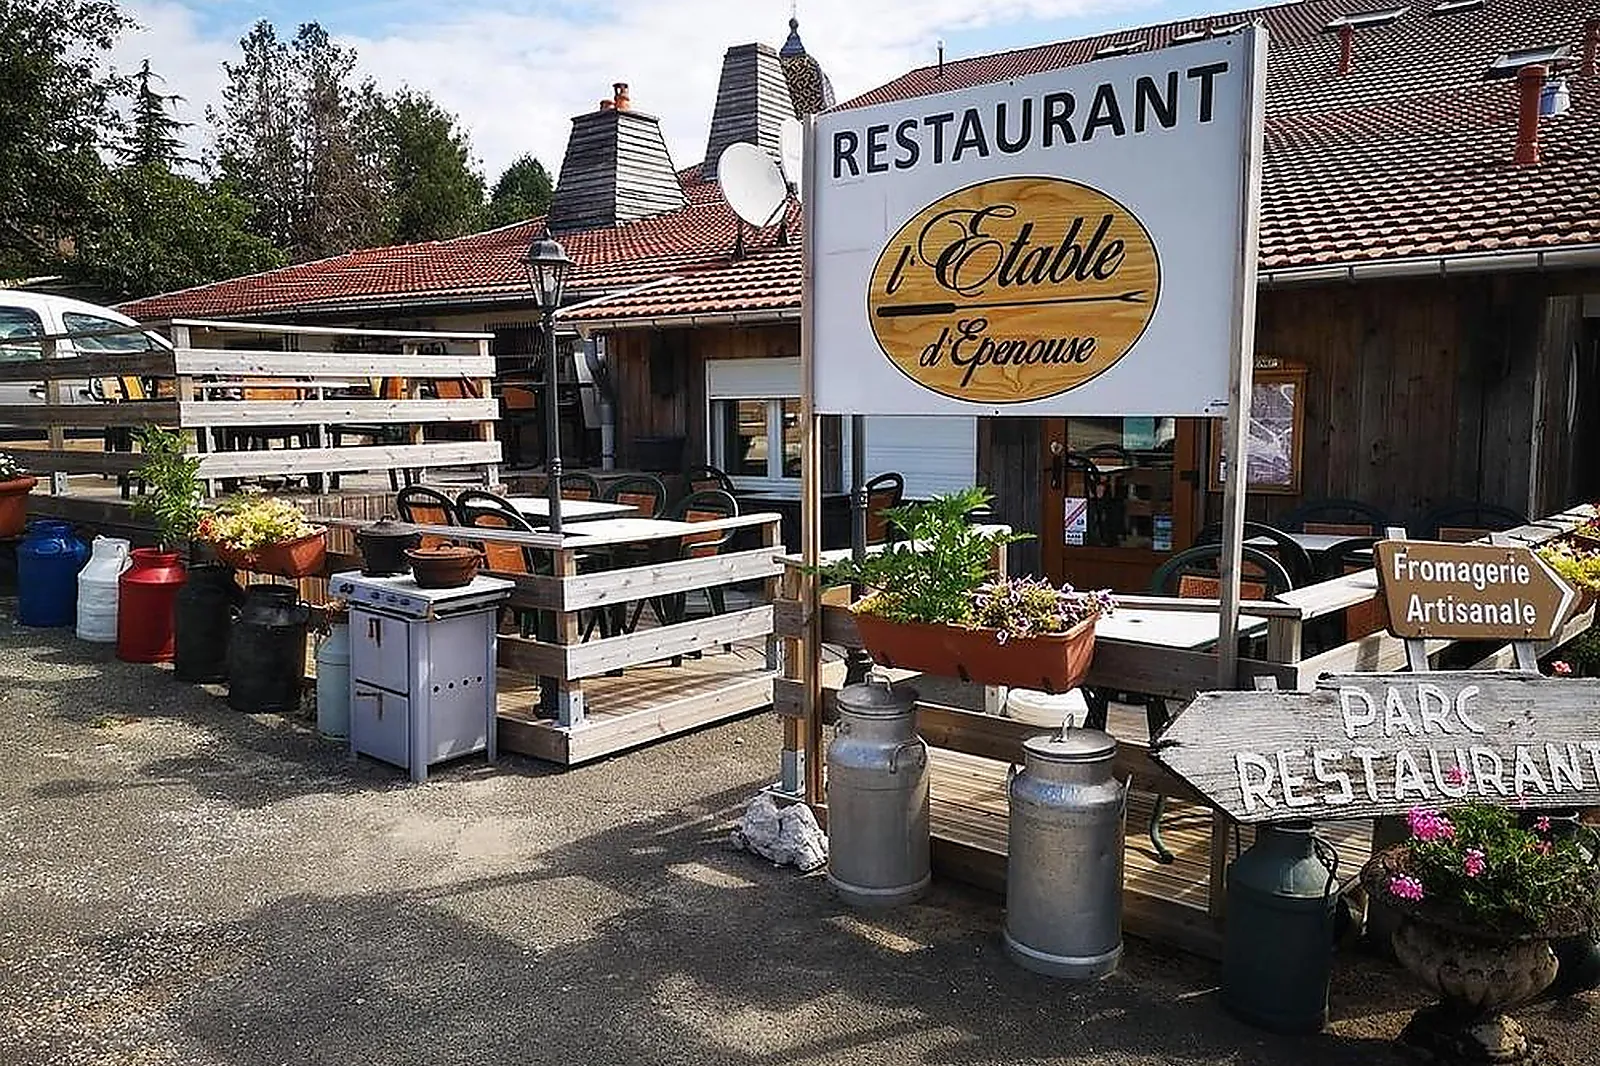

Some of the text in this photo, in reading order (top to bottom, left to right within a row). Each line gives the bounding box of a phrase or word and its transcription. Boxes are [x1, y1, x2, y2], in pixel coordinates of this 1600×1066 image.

[832, 61, 1229, 179] RESTAURANT
[886, 205, 1125, 297] l'Etable
[919, 318, 1097, 388] d'Epenouse
[1393, 553, 1531, 590] Fromagerie
[1406, 594, 1537, 626] Artisanale
[1338, 685, 1485, 738] PARC
